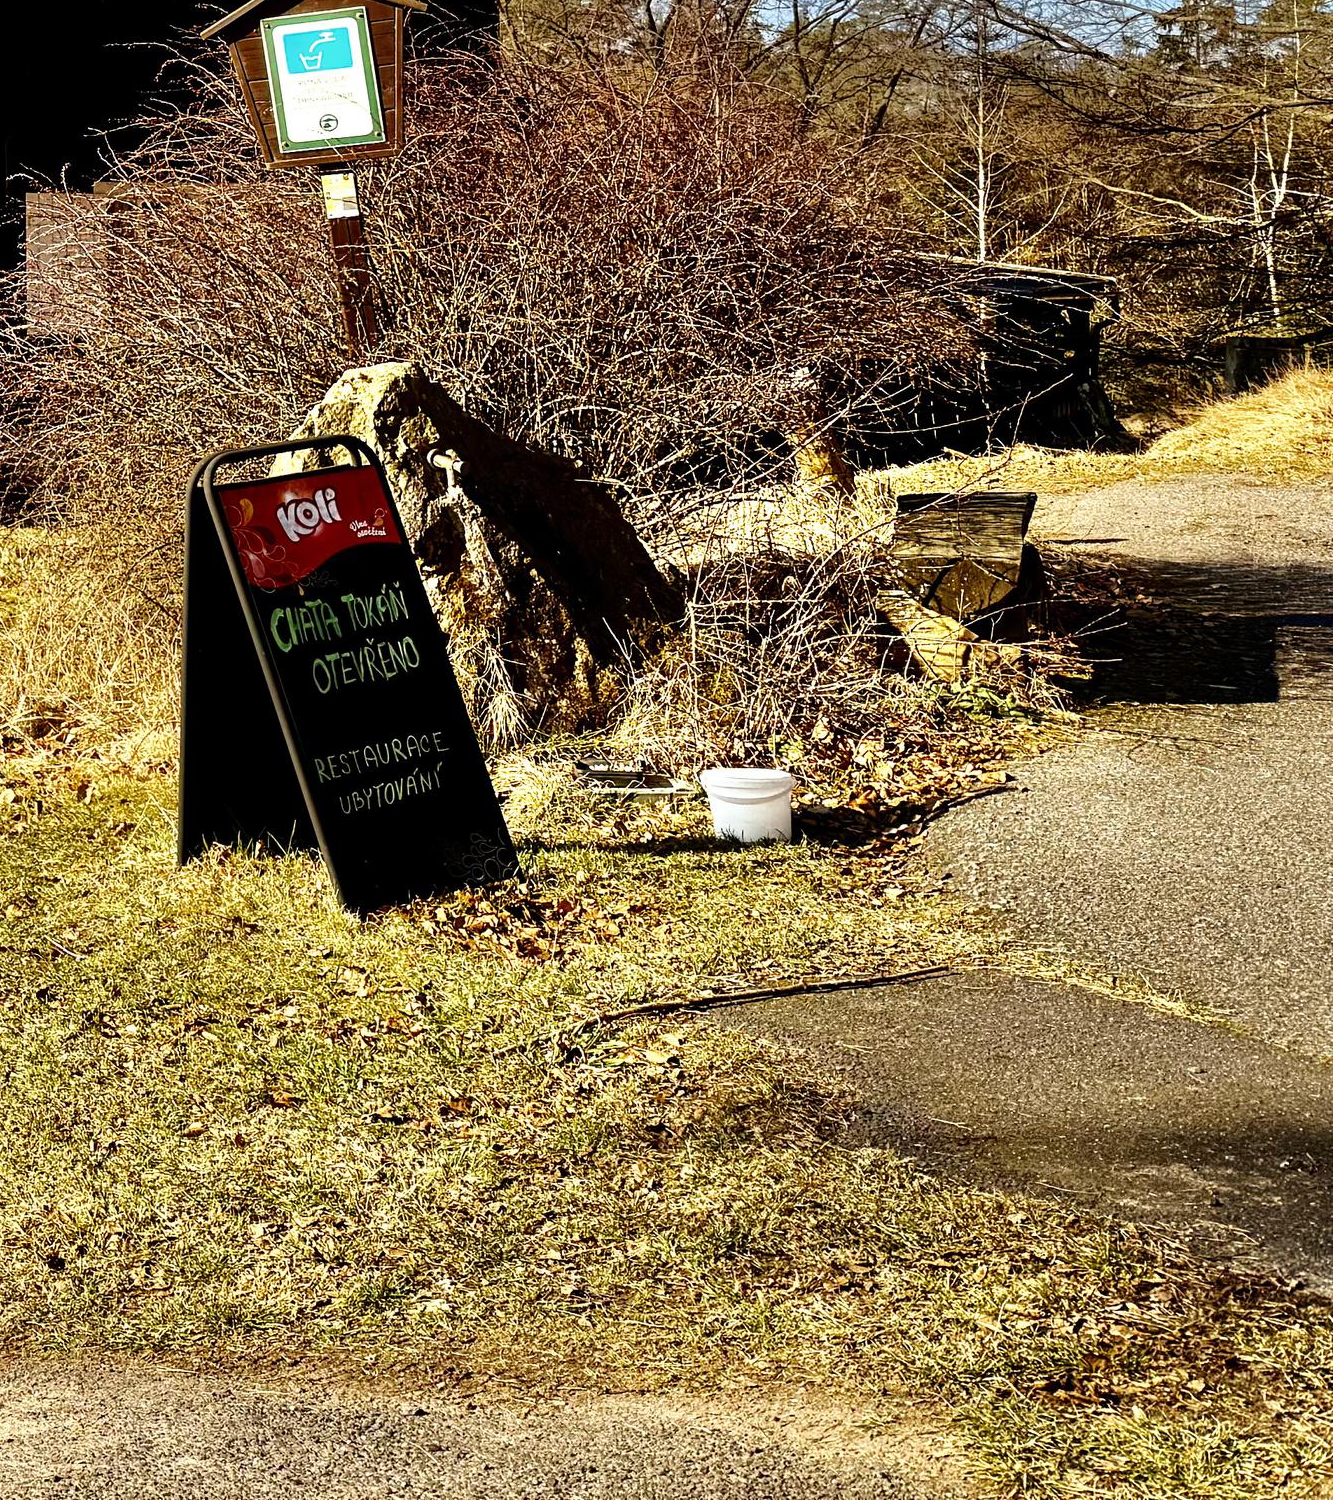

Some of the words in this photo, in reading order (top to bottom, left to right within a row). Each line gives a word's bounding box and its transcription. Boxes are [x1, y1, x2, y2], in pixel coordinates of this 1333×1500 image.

[270, 599, 342, 652] CHATA
[341, 581, 409, 631] TOKÁŇ
[312, 636, 420, 694] OTEVŘENO
[314, 731, 450, 783] RESTAURACE
[339, 761, 443, 814] UBYTOVÁNÍ
